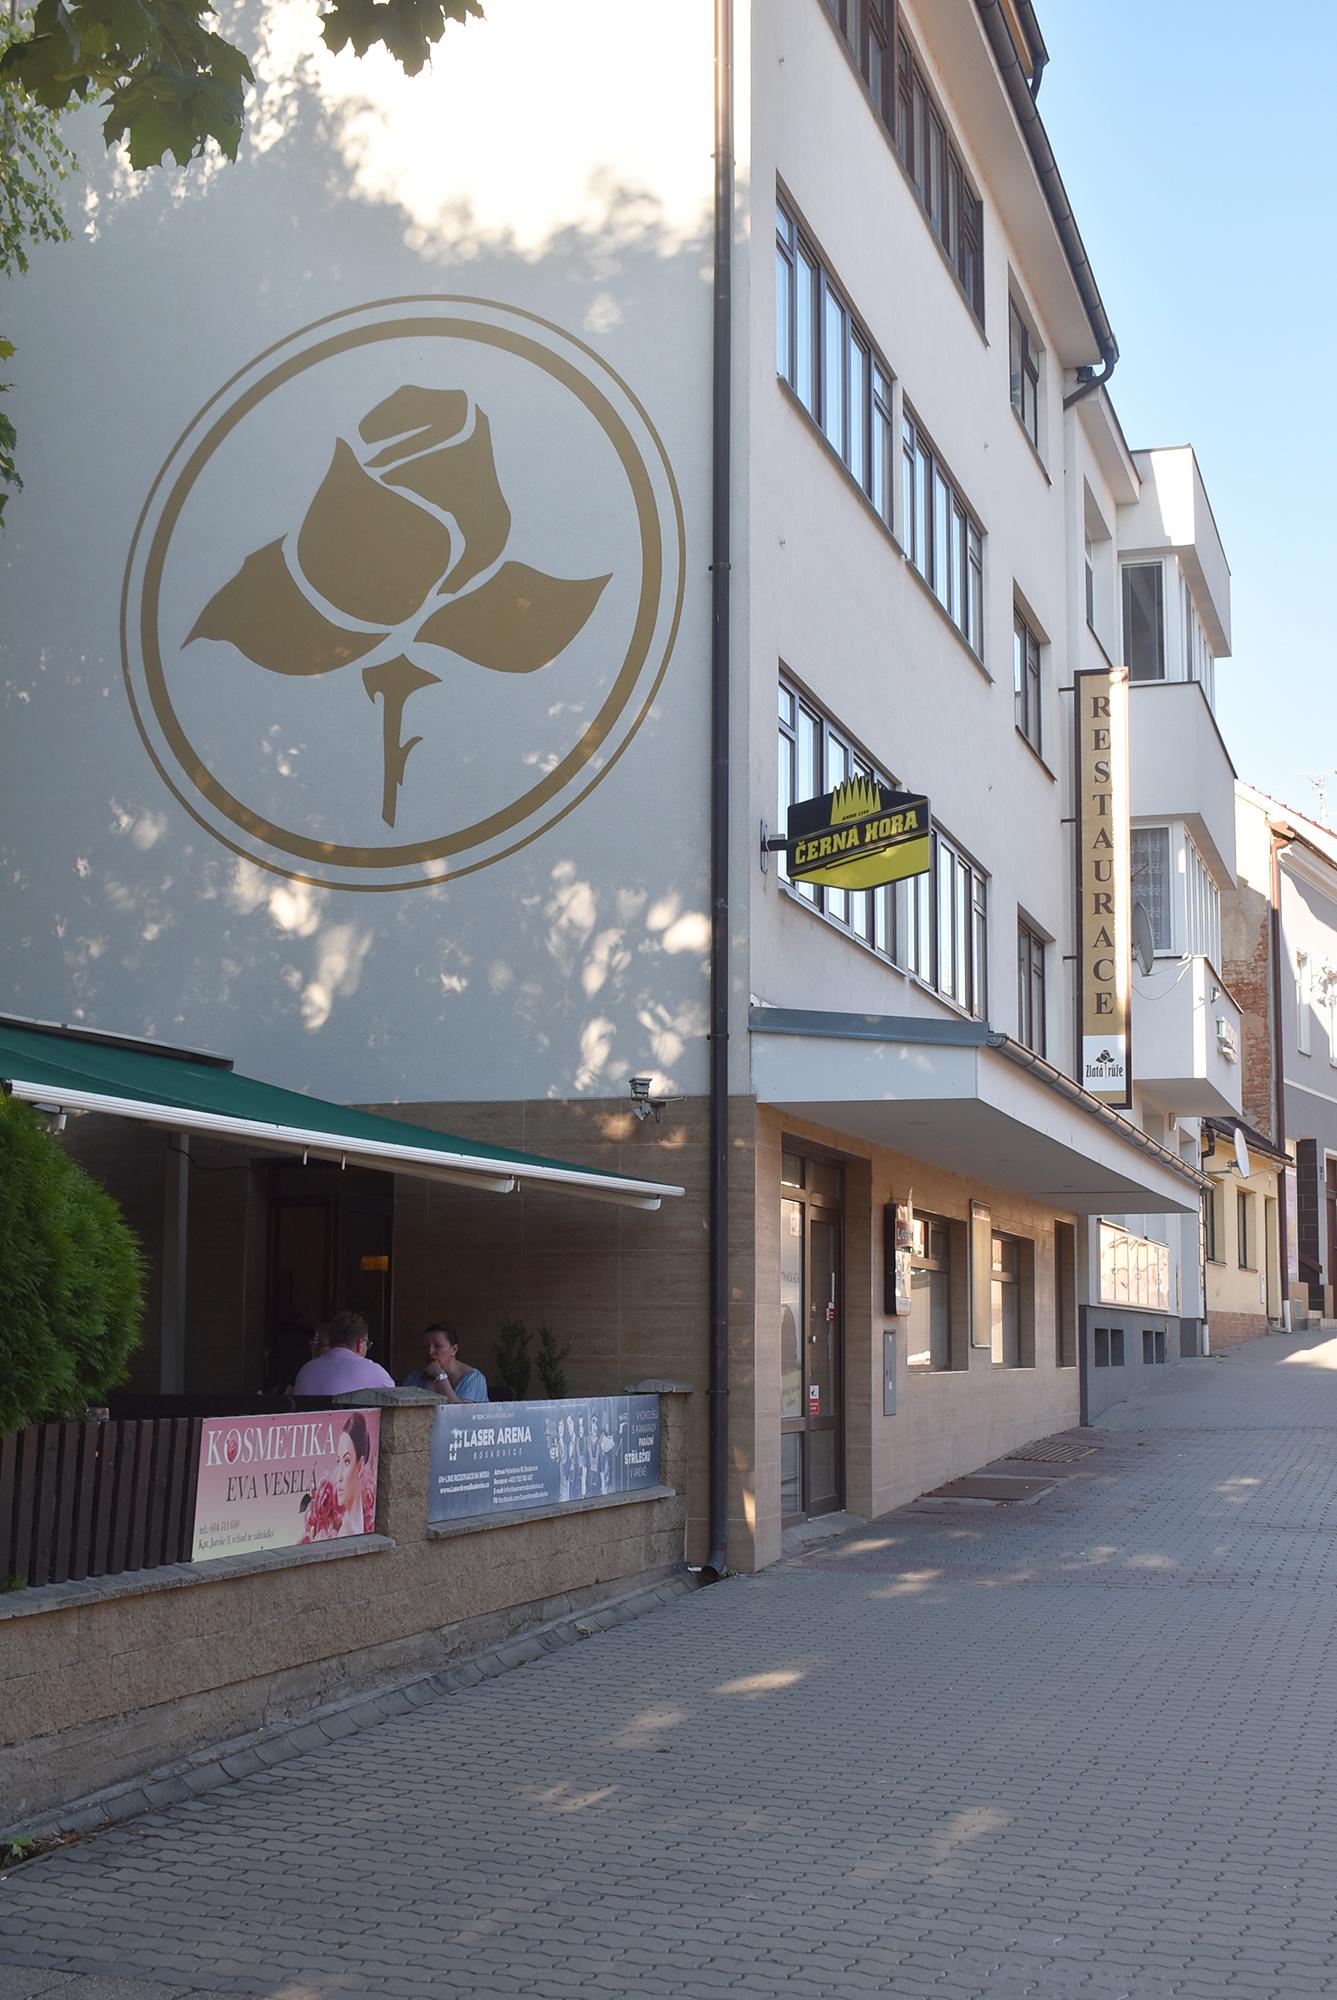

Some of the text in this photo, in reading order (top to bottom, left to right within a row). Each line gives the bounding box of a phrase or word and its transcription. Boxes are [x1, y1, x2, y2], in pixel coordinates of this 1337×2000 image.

[795, 809, 918, 865] ČERNÁ HORA
[1091, 695, 1114, 1016] RESTAURACE
[1085, 1064, 1124, 1078] Zlatá růže
[205, 1423, 336, 1466] KOSMETIKA
[463, 1426, 532, 1448] LASER ARENA
[473, 1447, 523, 1460] BOSKOVICE
[226, 1461, 318, 1502] EVA VESELÁ
